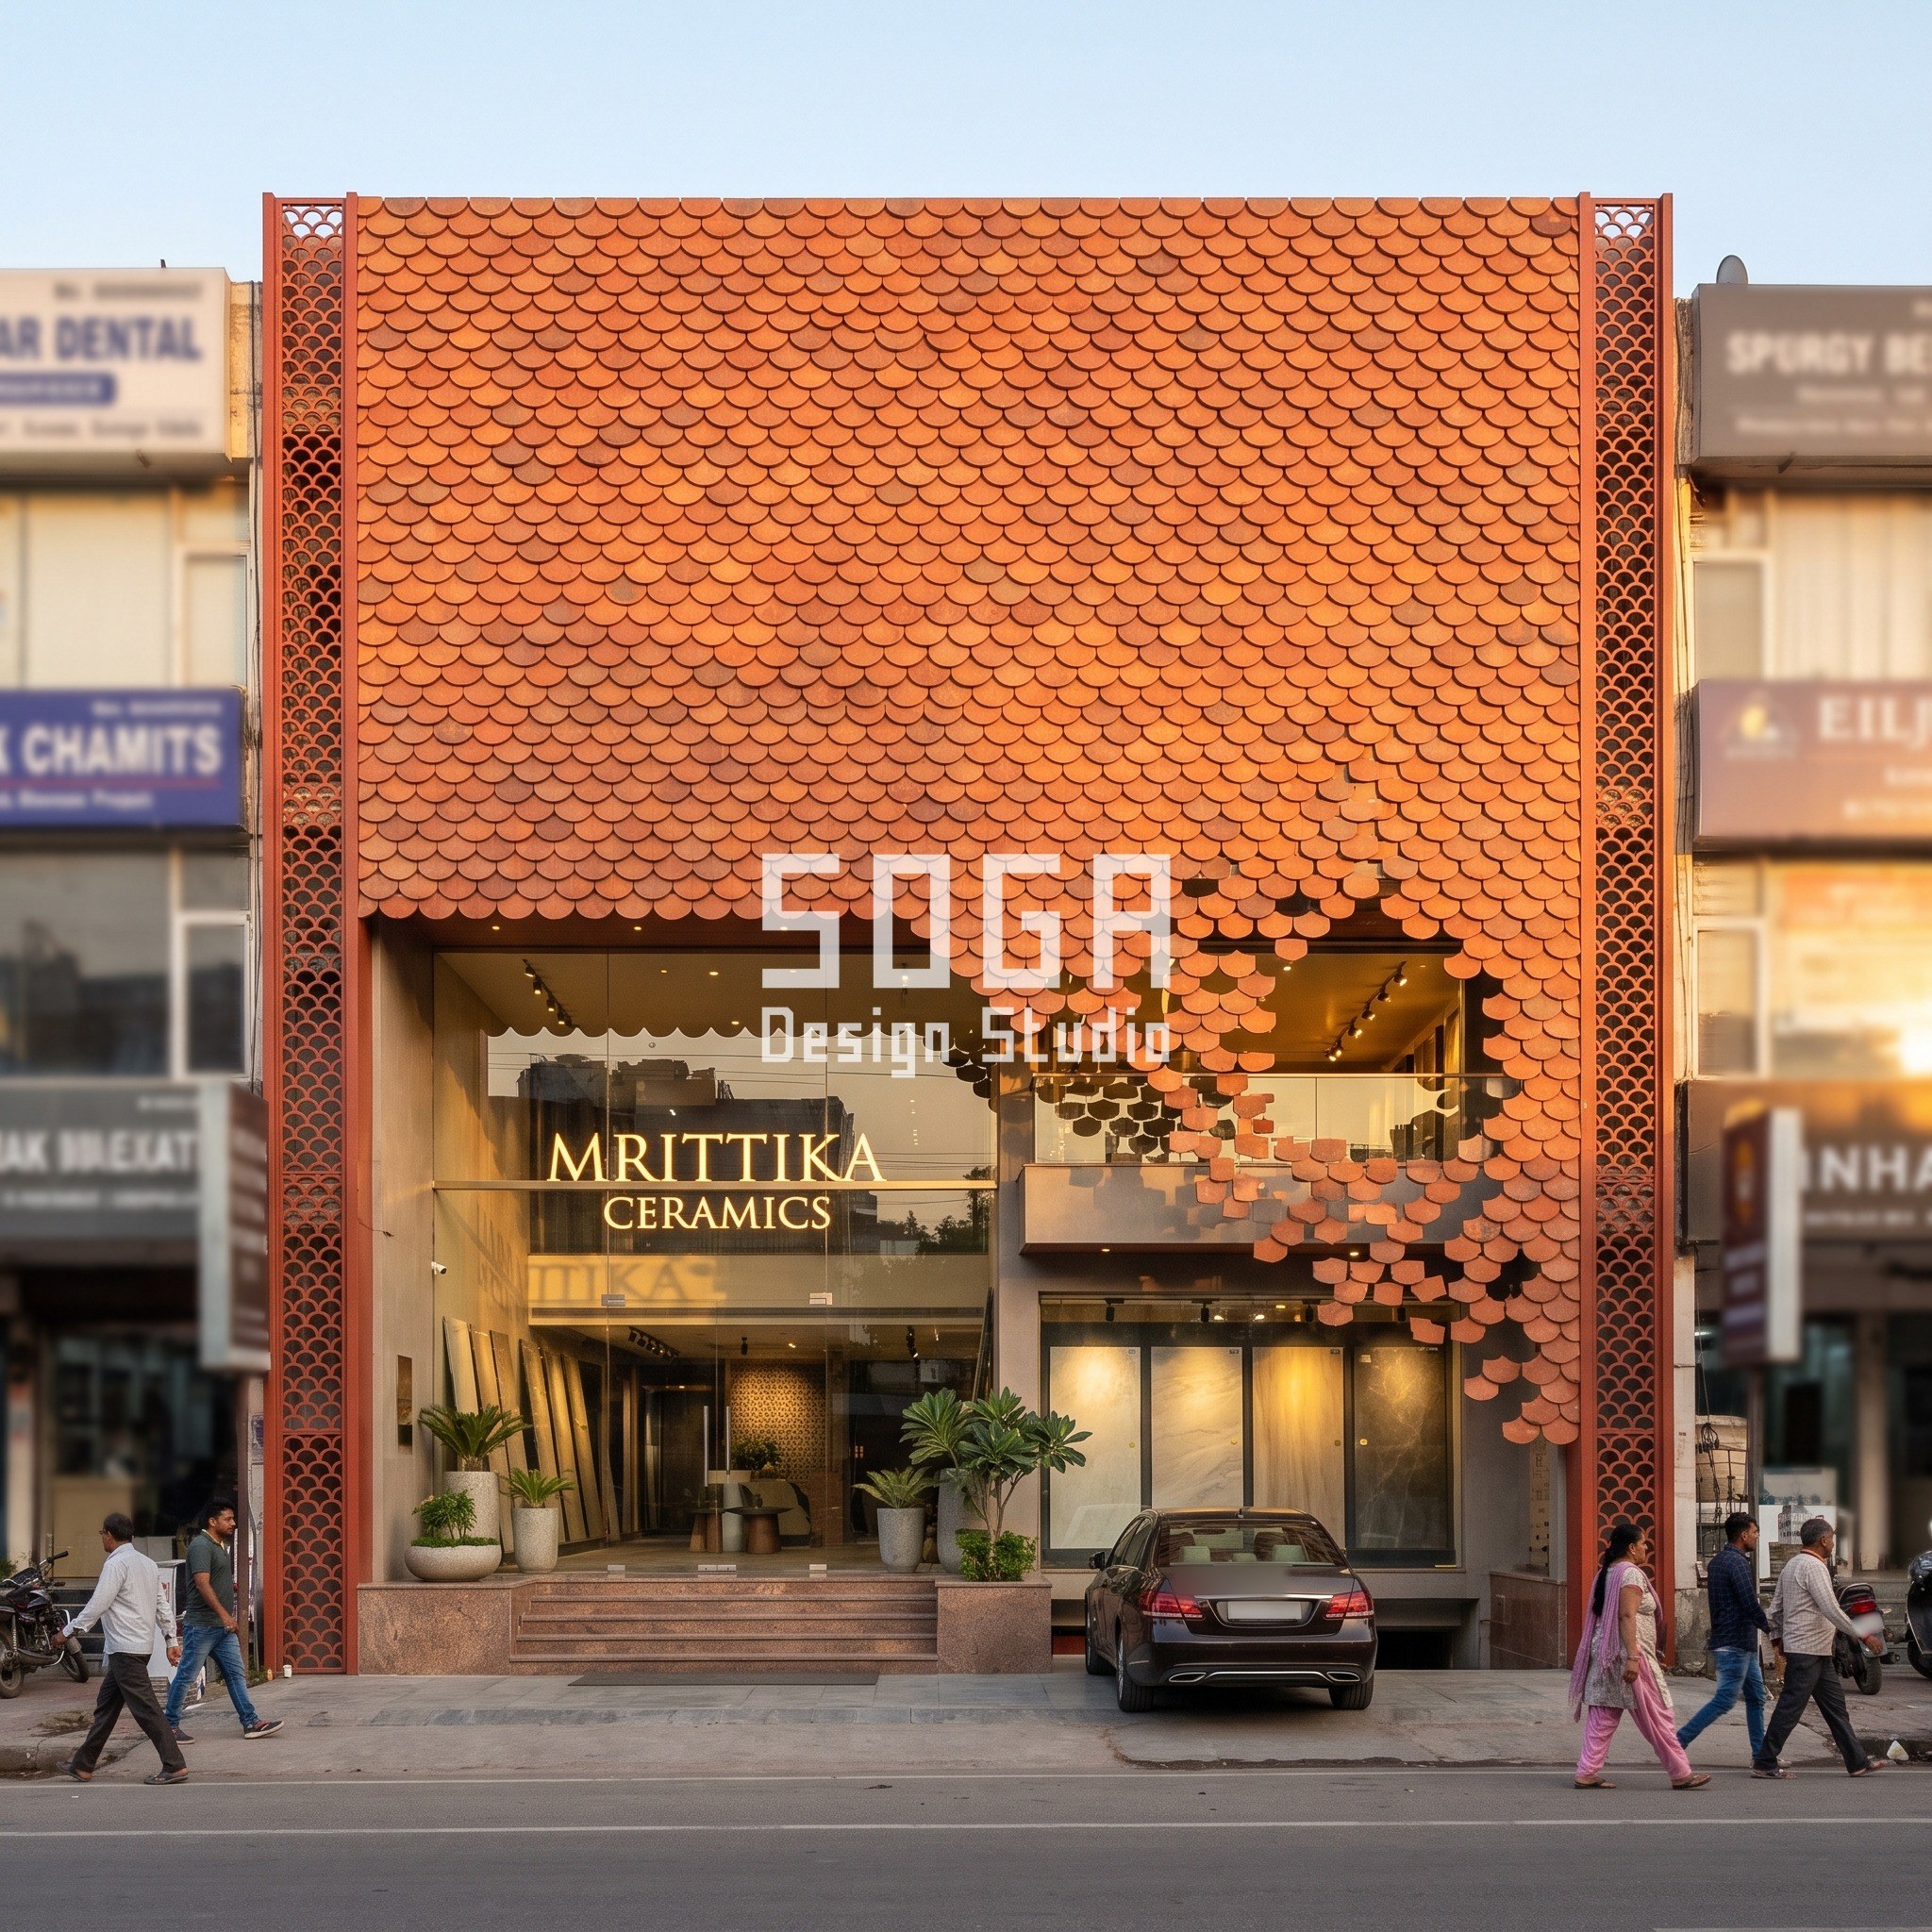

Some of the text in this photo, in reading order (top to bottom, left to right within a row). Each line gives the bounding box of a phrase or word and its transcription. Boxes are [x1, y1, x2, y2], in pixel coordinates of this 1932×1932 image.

[56, 316, 202, 361] DENTAL
[23, 723, 222, 775] CHAMITS
[546, 1132, 887, 1182] MRITTIKA
[604, 1196, 831, 1229] CERAMICS
